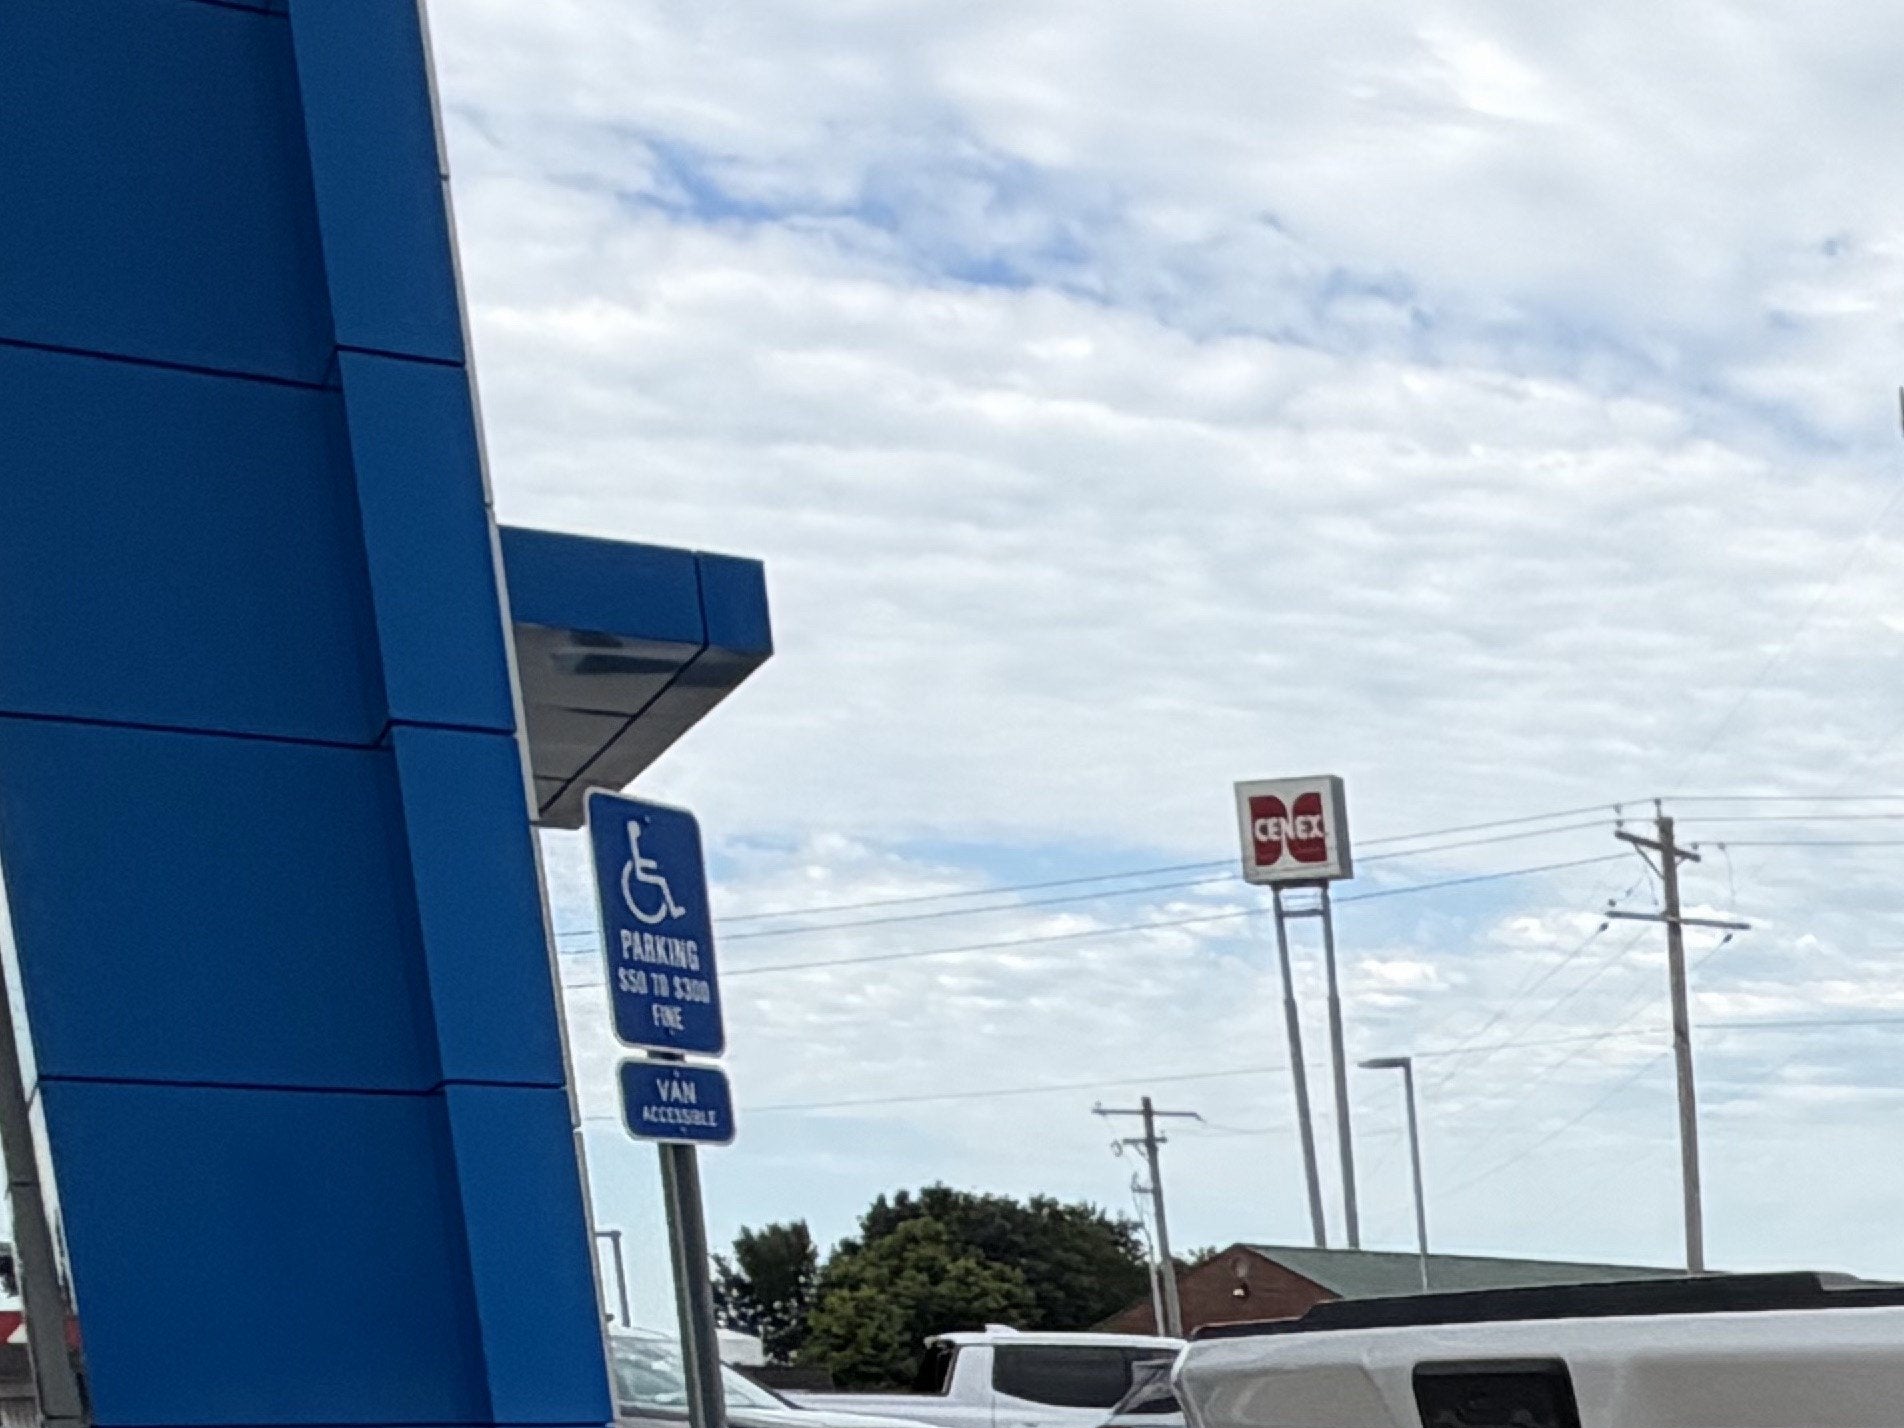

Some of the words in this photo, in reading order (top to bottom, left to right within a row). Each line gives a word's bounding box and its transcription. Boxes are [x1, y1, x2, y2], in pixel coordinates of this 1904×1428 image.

[1254, 814, 1325, 842] CENEX
[620, 929, 700, 971] PARKING
[618, 966, 647, 993] $50
[651, 972, 670, 997] TO
[674, 976, 710, 1003] $300
[652, 1003, 685, 1031] FINE
[656, 1078, 697, 1104] VAN
[642, 1104, 718, 1127] ACCESSIBLE
